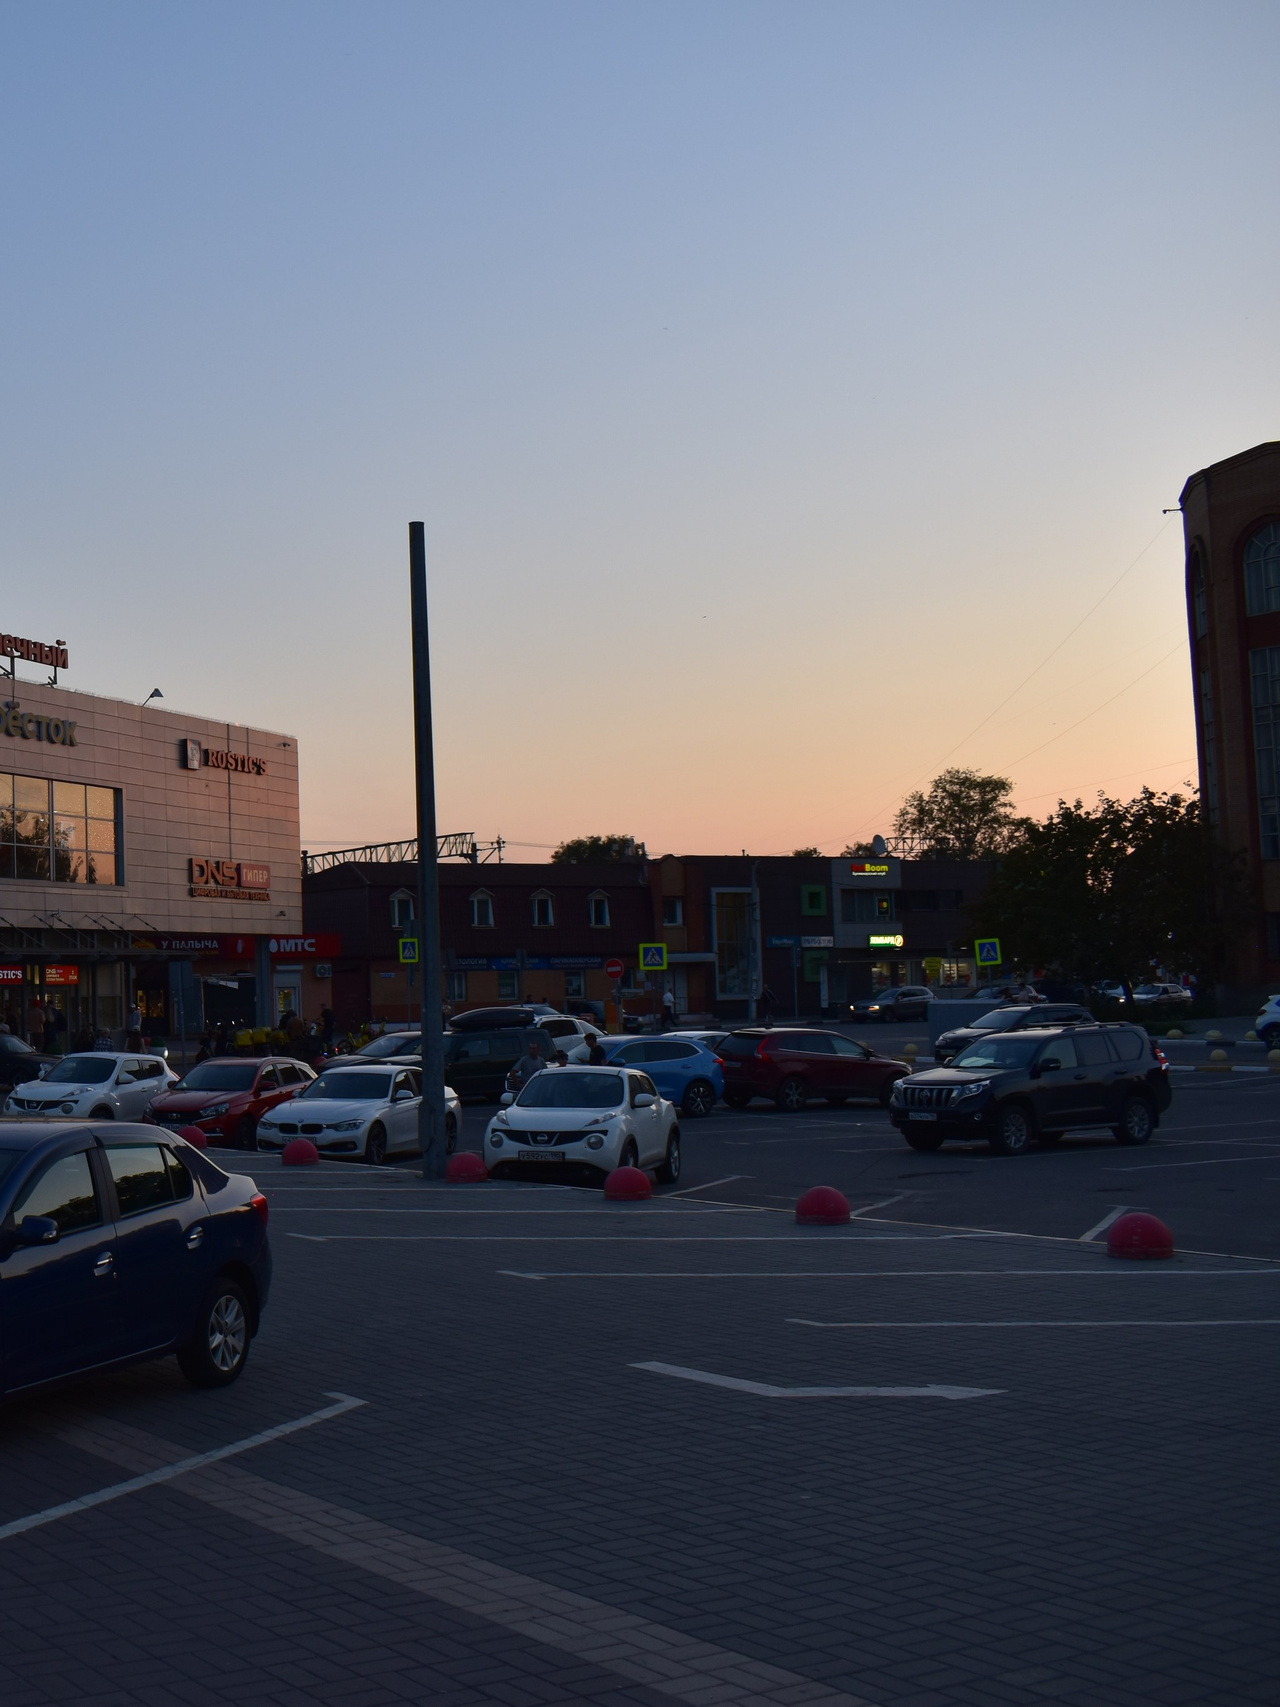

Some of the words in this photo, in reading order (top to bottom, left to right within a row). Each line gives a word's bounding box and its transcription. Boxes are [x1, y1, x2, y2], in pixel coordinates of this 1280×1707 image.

[206, 749, 268, 775] ROSTIC'S
[190, 858, 237, 886] DNS
[242, 869, 268, 882] ГИПЕР
[161, 940, 169, 949] У
[172, 940, 219, 949] ПАЛЫЧА
[280, 938, 316, 952] МТС
